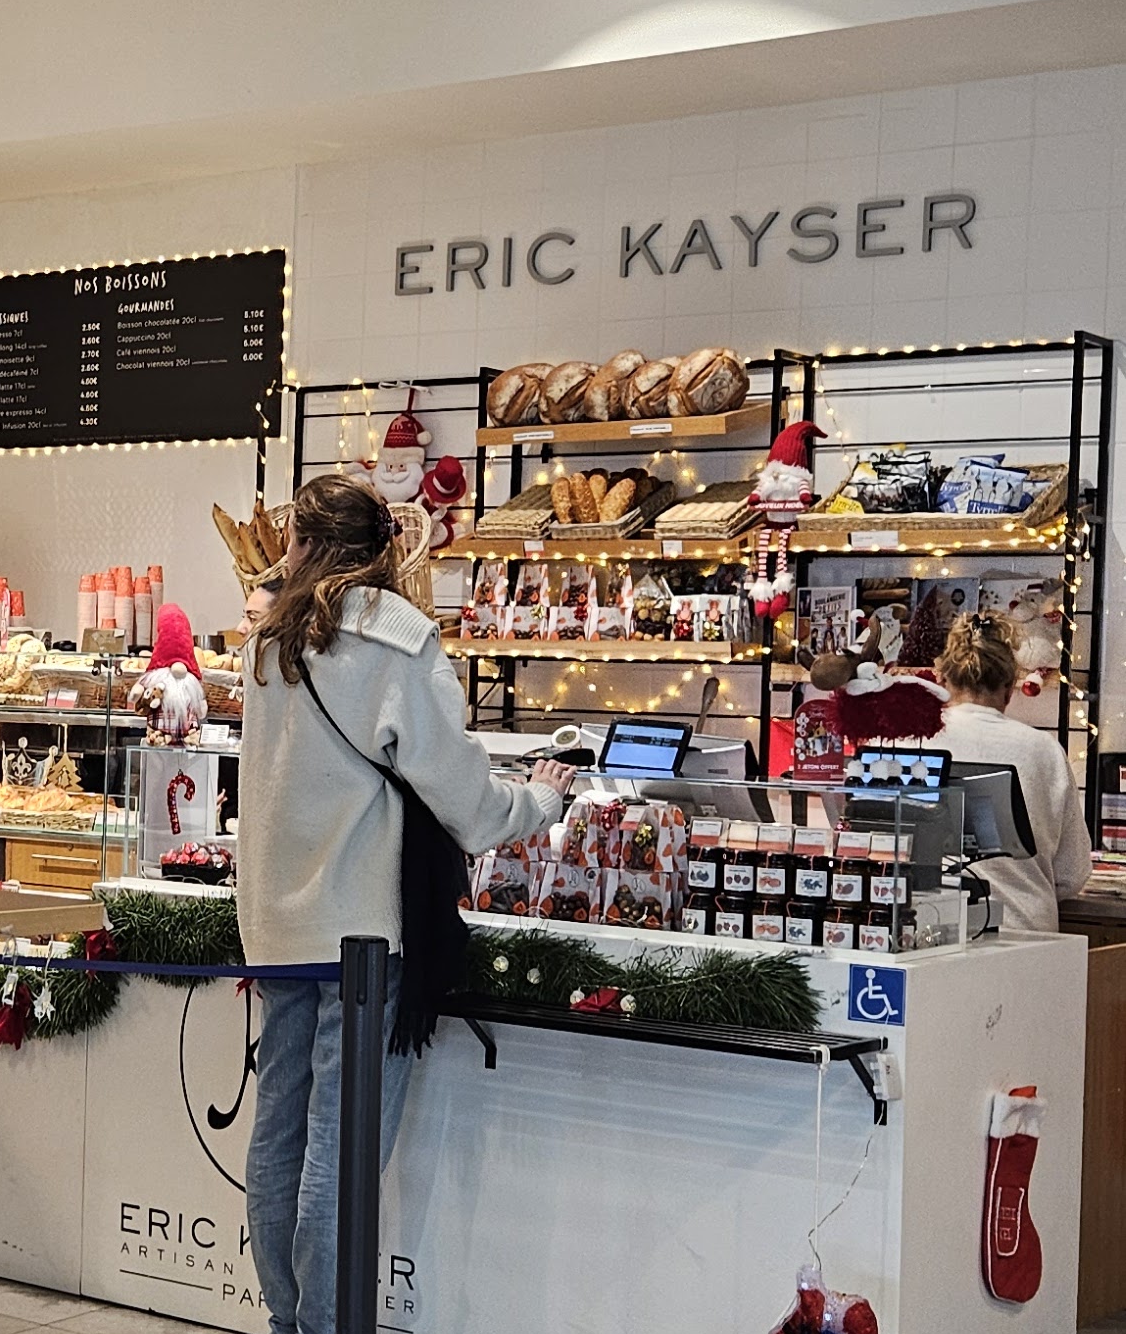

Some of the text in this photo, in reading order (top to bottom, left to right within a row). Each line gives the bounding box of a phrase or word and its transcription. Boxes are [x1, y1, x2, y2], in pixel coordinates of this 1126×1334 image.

[393, 193, 978, 297] ERIC KAYSER
[74, 270, 167, 295] NOS BOISSONS
[117, 298, 175, 315] GOURMANDES
[119, 1202, 216, 1249] ERIC
[120, 1241, 235, 1276] ARTISAN
